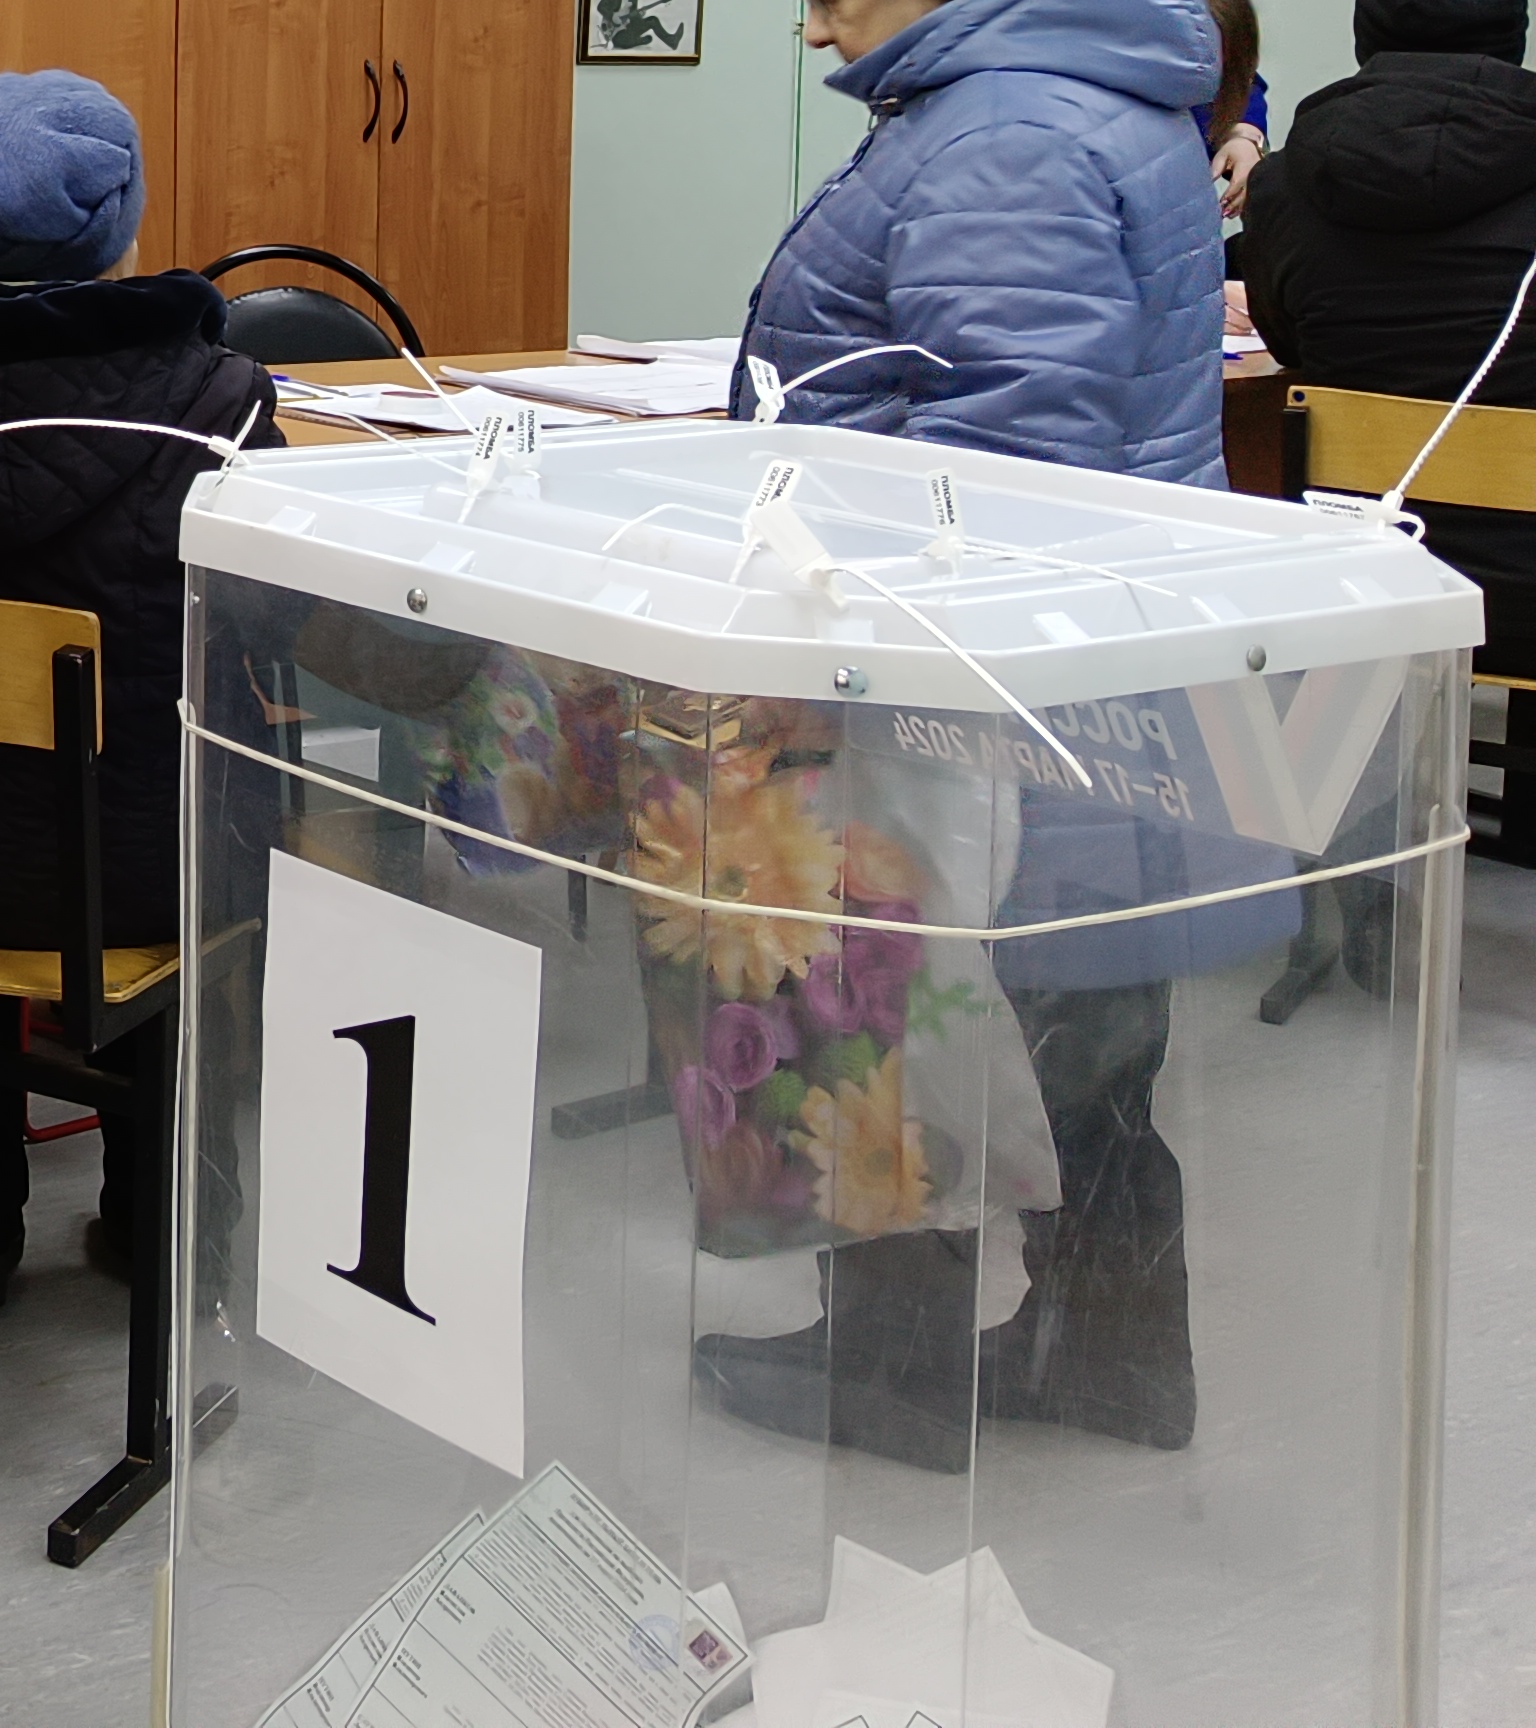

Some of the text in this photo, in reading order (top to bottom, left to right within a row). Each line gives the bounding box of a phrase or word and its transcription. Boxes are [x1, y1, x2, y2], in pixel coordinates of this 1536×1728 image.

[483, 416, 503, 459] ПЛОМБА
[770, 466, 795, 502] ПЛОМ
[941, 475, 955, 525] ПЛОМБА
[326, 1014, 437, 1327] 1
